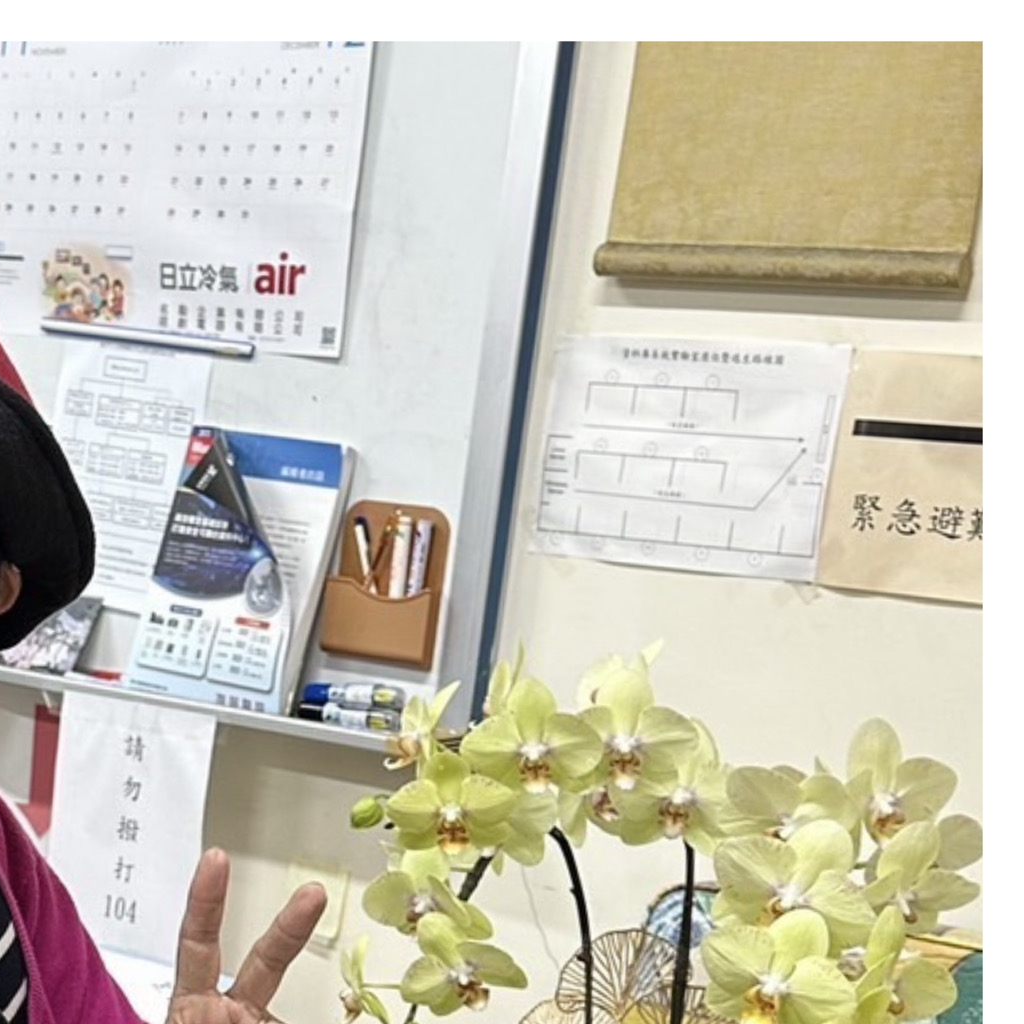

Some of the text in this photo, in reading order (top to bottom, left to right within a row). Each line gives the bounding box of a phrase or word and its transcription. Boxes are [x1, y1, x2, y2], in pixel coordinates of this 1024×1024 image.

[160, 262, 239, 293] 日立冷氣
[254, 252, 306, 295] air
[104, 894, 137, 924] 104
